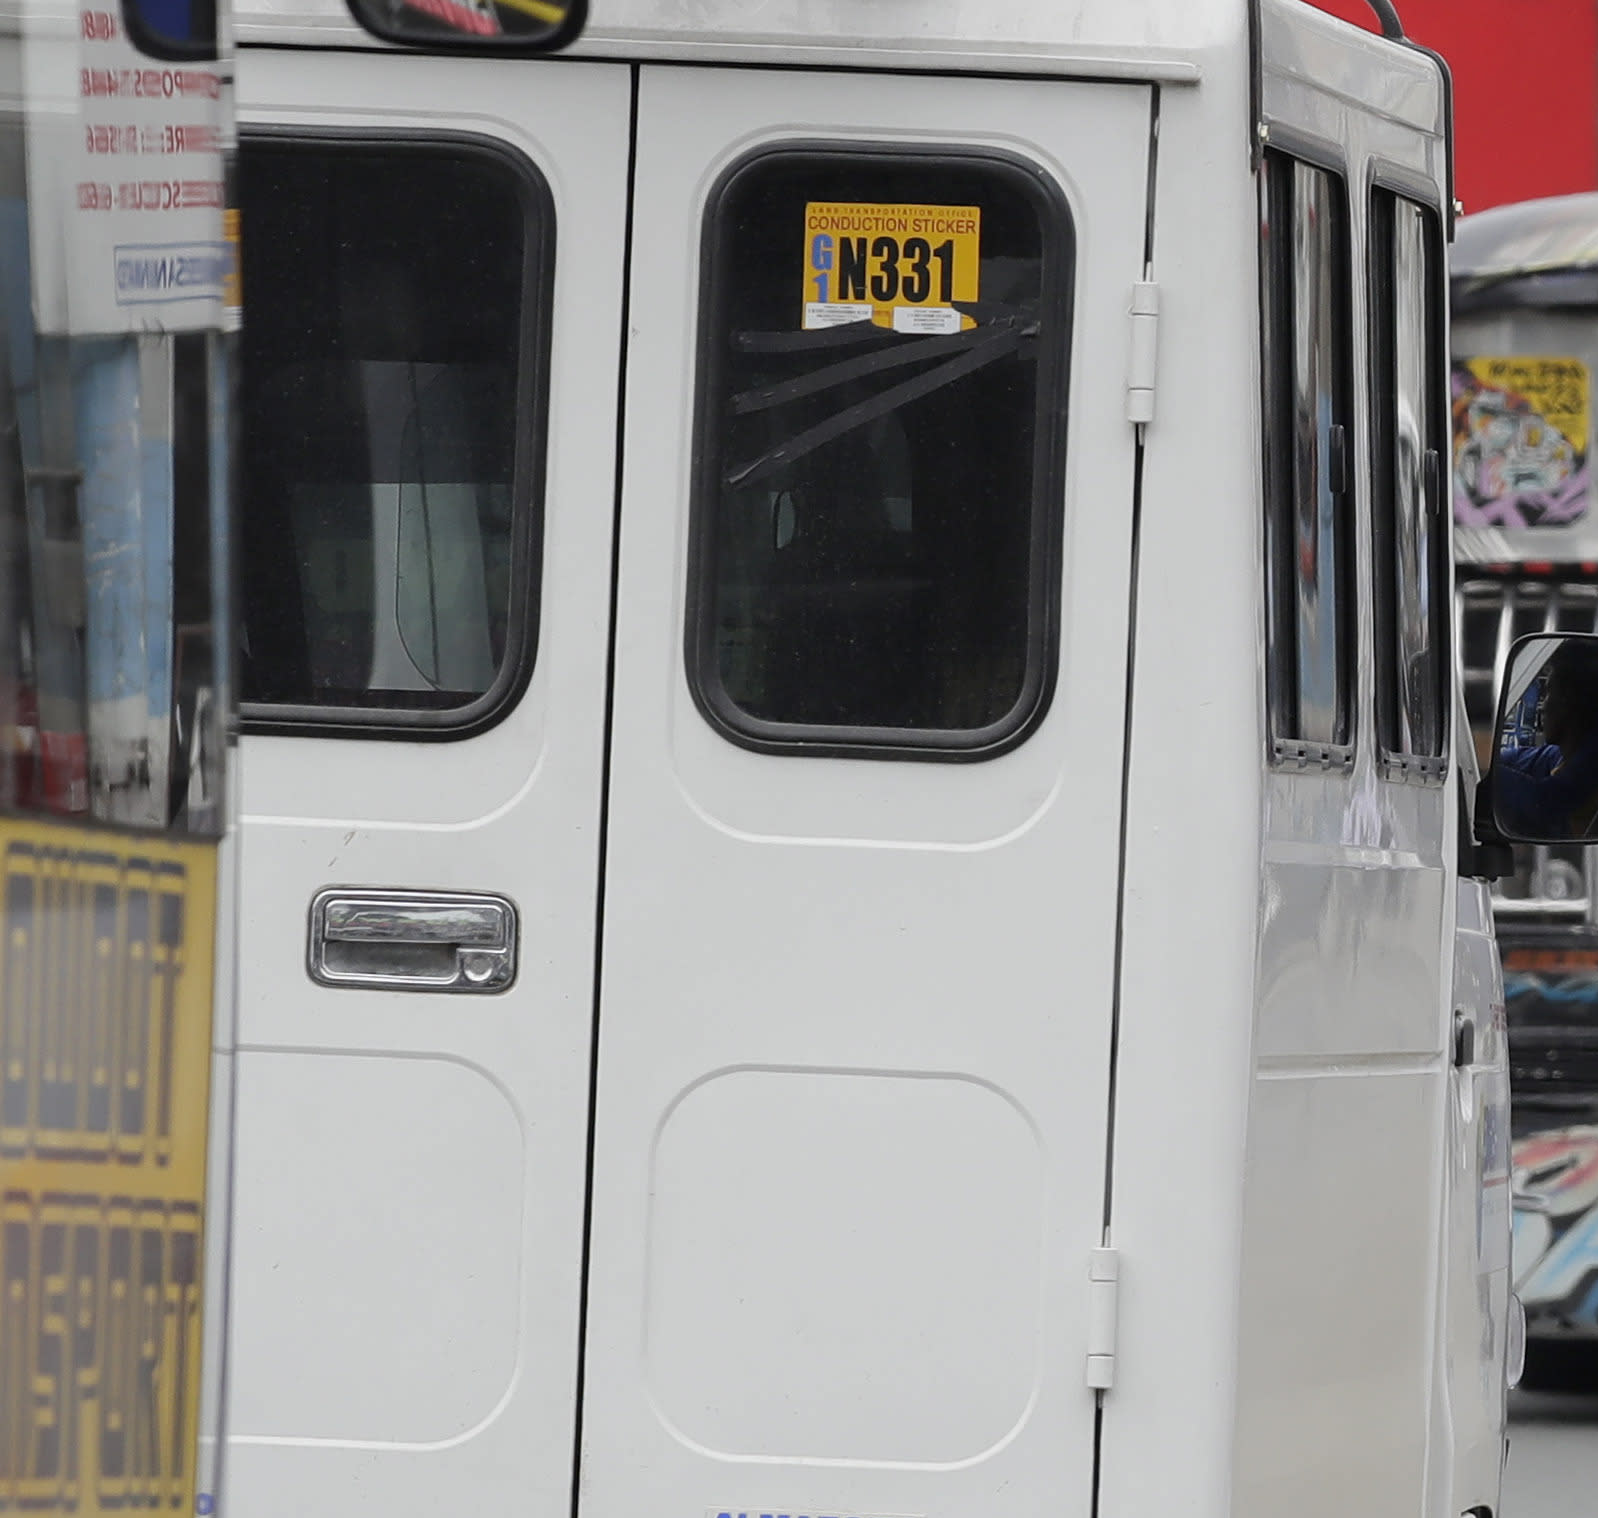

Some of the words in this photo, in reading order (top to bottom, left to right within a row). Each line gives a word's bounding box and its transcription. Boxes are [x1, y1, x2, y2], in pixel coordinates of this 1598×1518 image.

[807, 216, 908, 232] CONDUCTION
[912, 218, 976, 234] STICKER
[837, 235, 955, 303] N331
